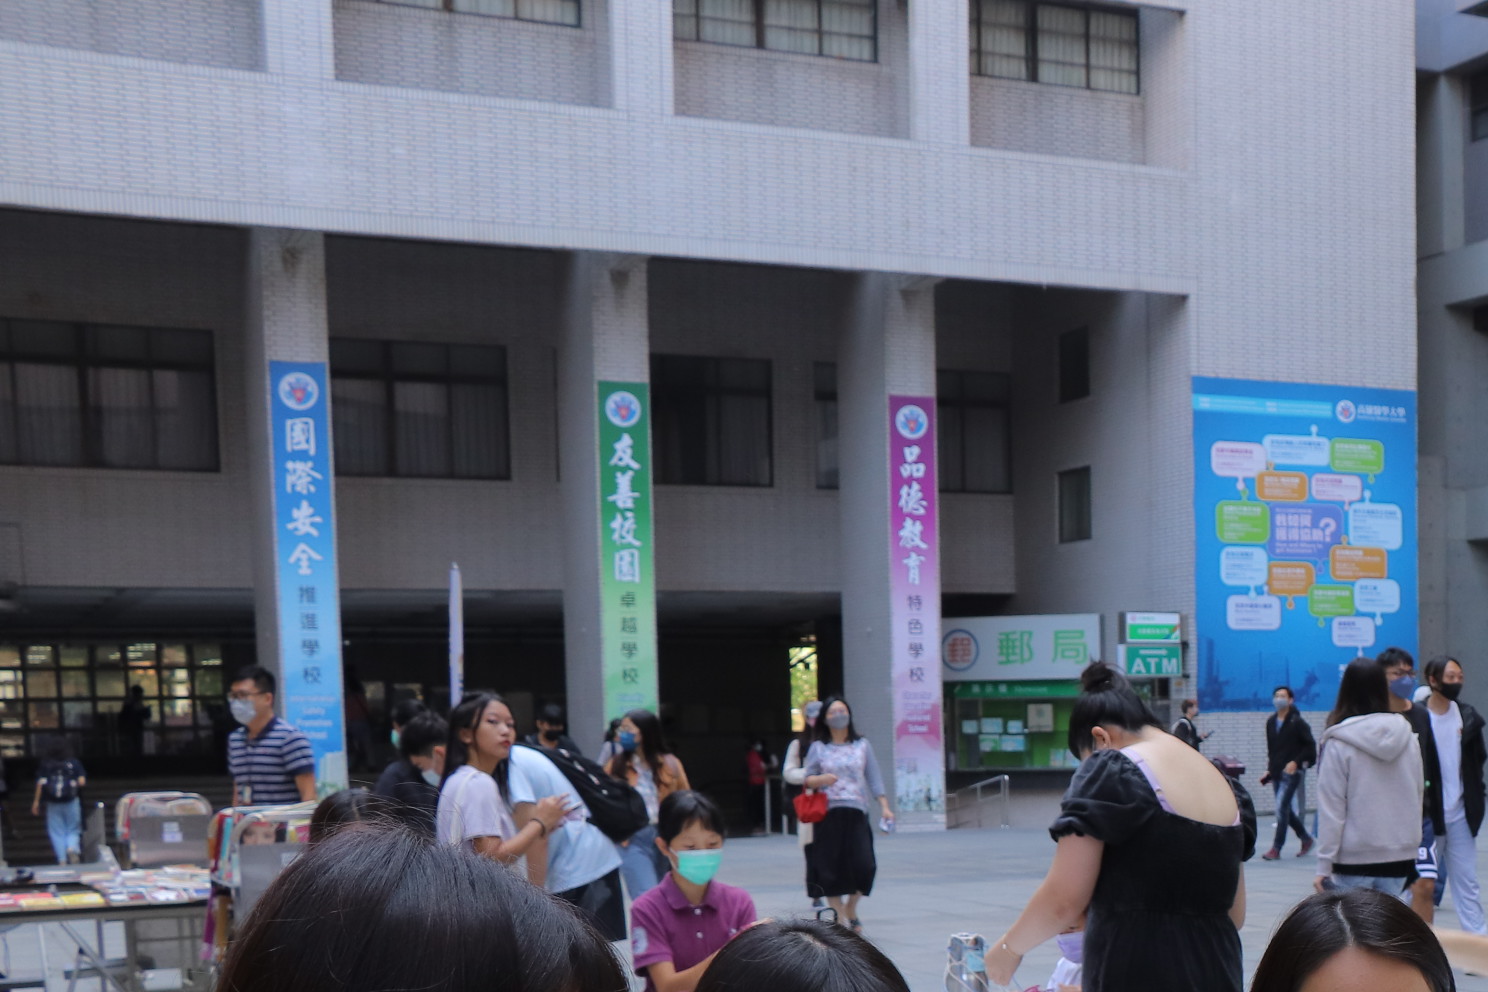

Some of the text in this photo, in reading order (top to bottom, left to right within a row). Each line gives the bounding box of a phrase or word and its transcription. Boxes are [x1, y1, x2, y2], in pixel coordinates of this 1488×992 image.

[284, 417, 323, 576] 國際安全
[606, 432, 642, 584] 友善校園
[898, 444, 928, 585] 品德教育
[298, 586, 322, 685] 推進學校
[620, 591, 639, 685] 卓越學校
[907, 594, 925, 683] 特色學校
[996, 629, 1089, 666] 郵局
[1131, 657, 1178, 674] ATM
